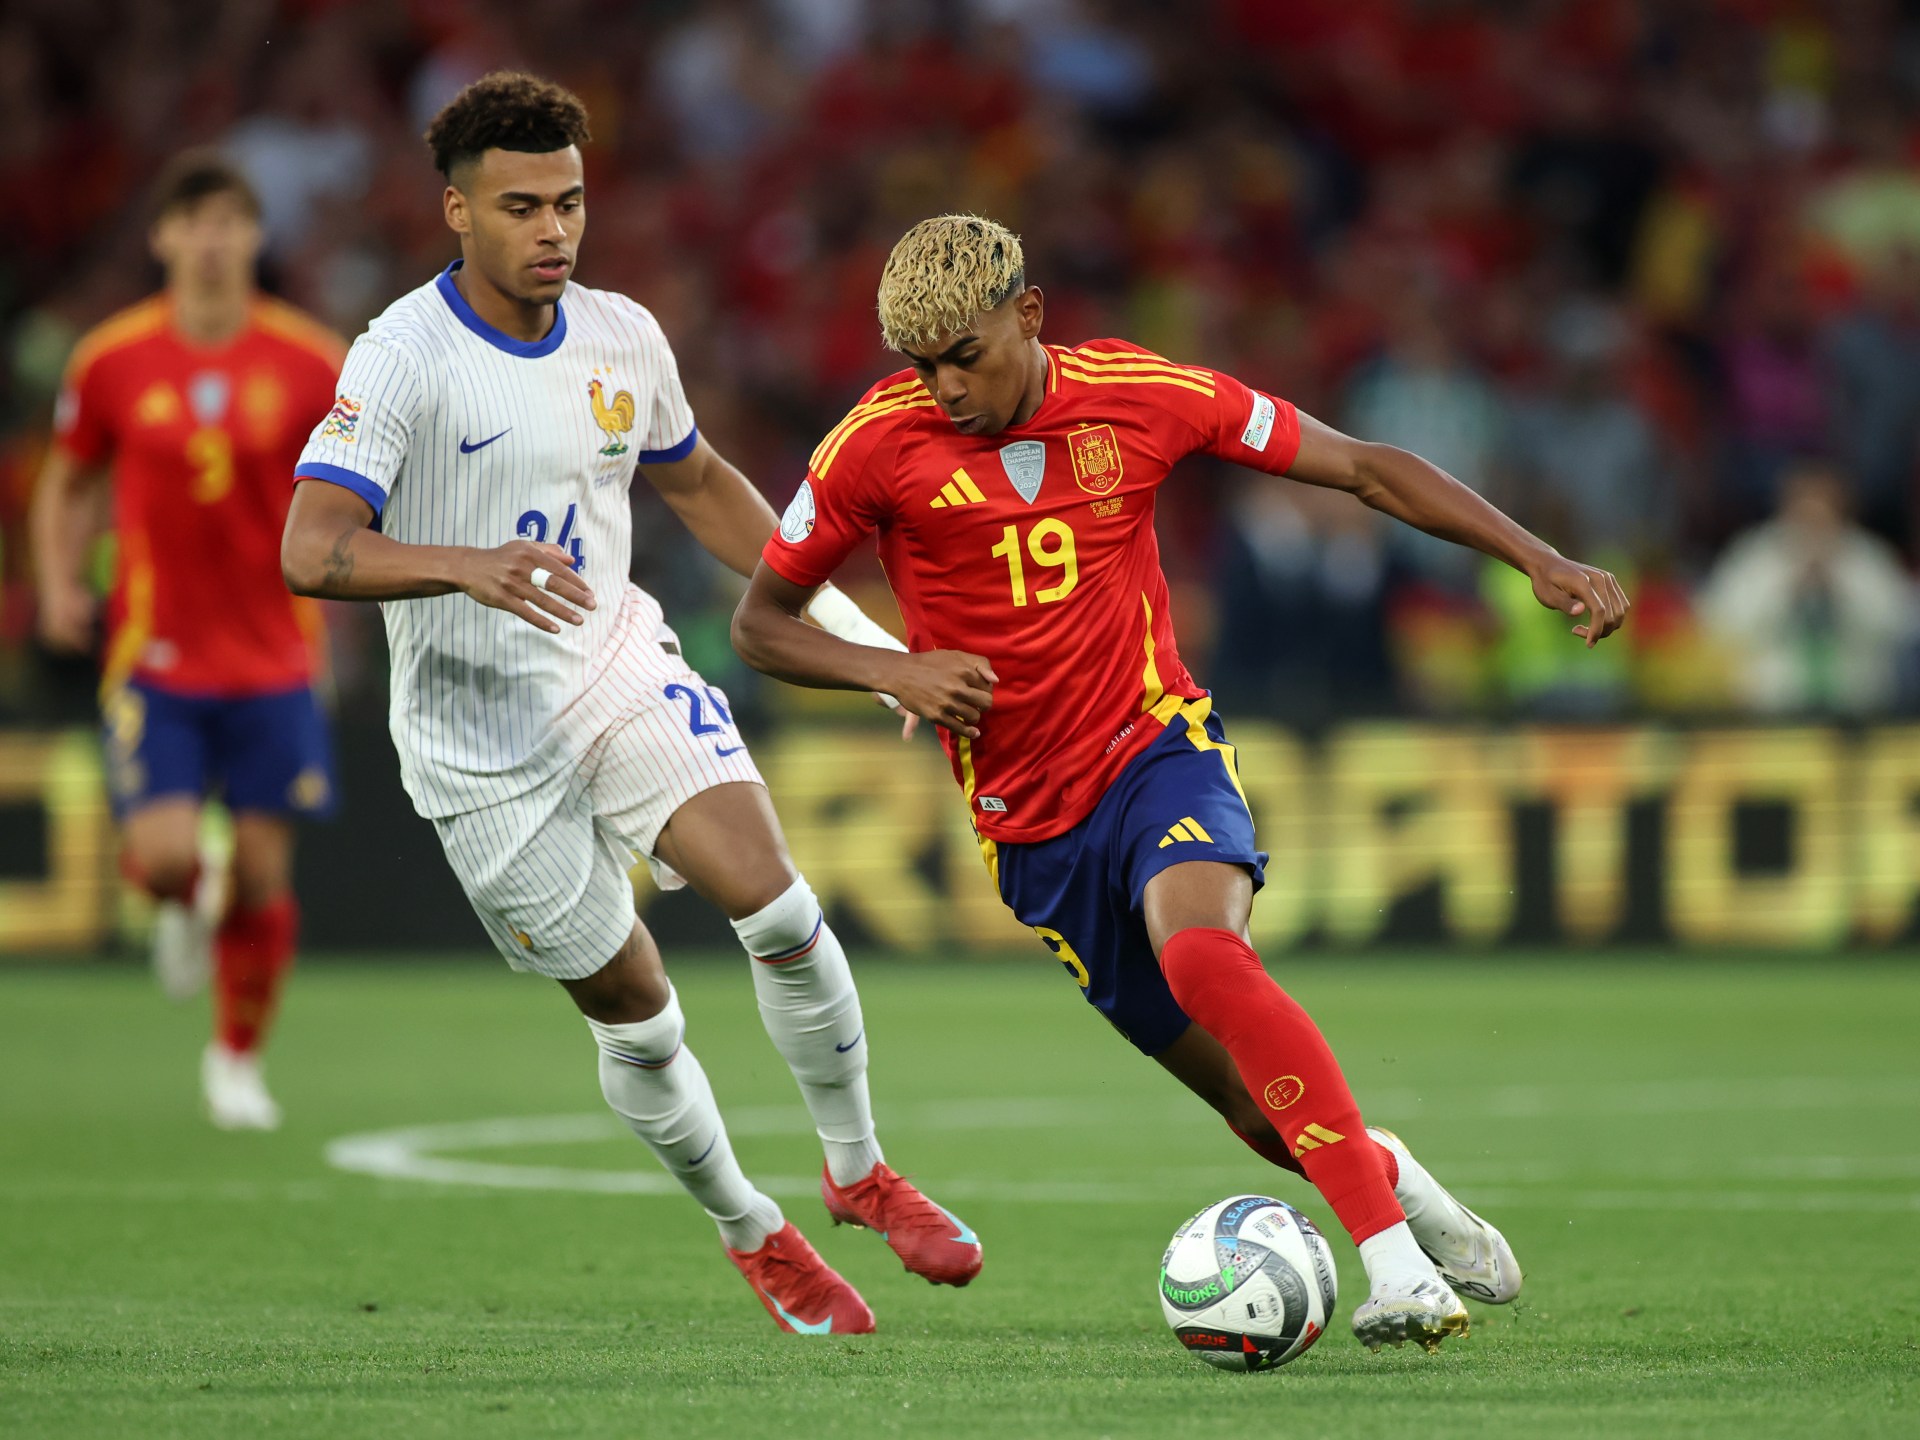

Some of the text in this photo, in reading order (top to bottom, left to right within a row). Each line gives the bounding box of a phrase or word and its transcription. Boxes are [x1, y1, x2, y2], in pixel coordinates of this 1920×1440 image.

[1004, 448, 1042, 460] EUROPEAN
[1005, 454, 1042, 466] CHAMPIONS
[1019, 481, 1038, 490] 2024
[991, 517, 1079, 607] 19
[1222, 1198, 1271, 1226] LEAGUE
[1165, 1281, 1220, 1304] NATIONS
